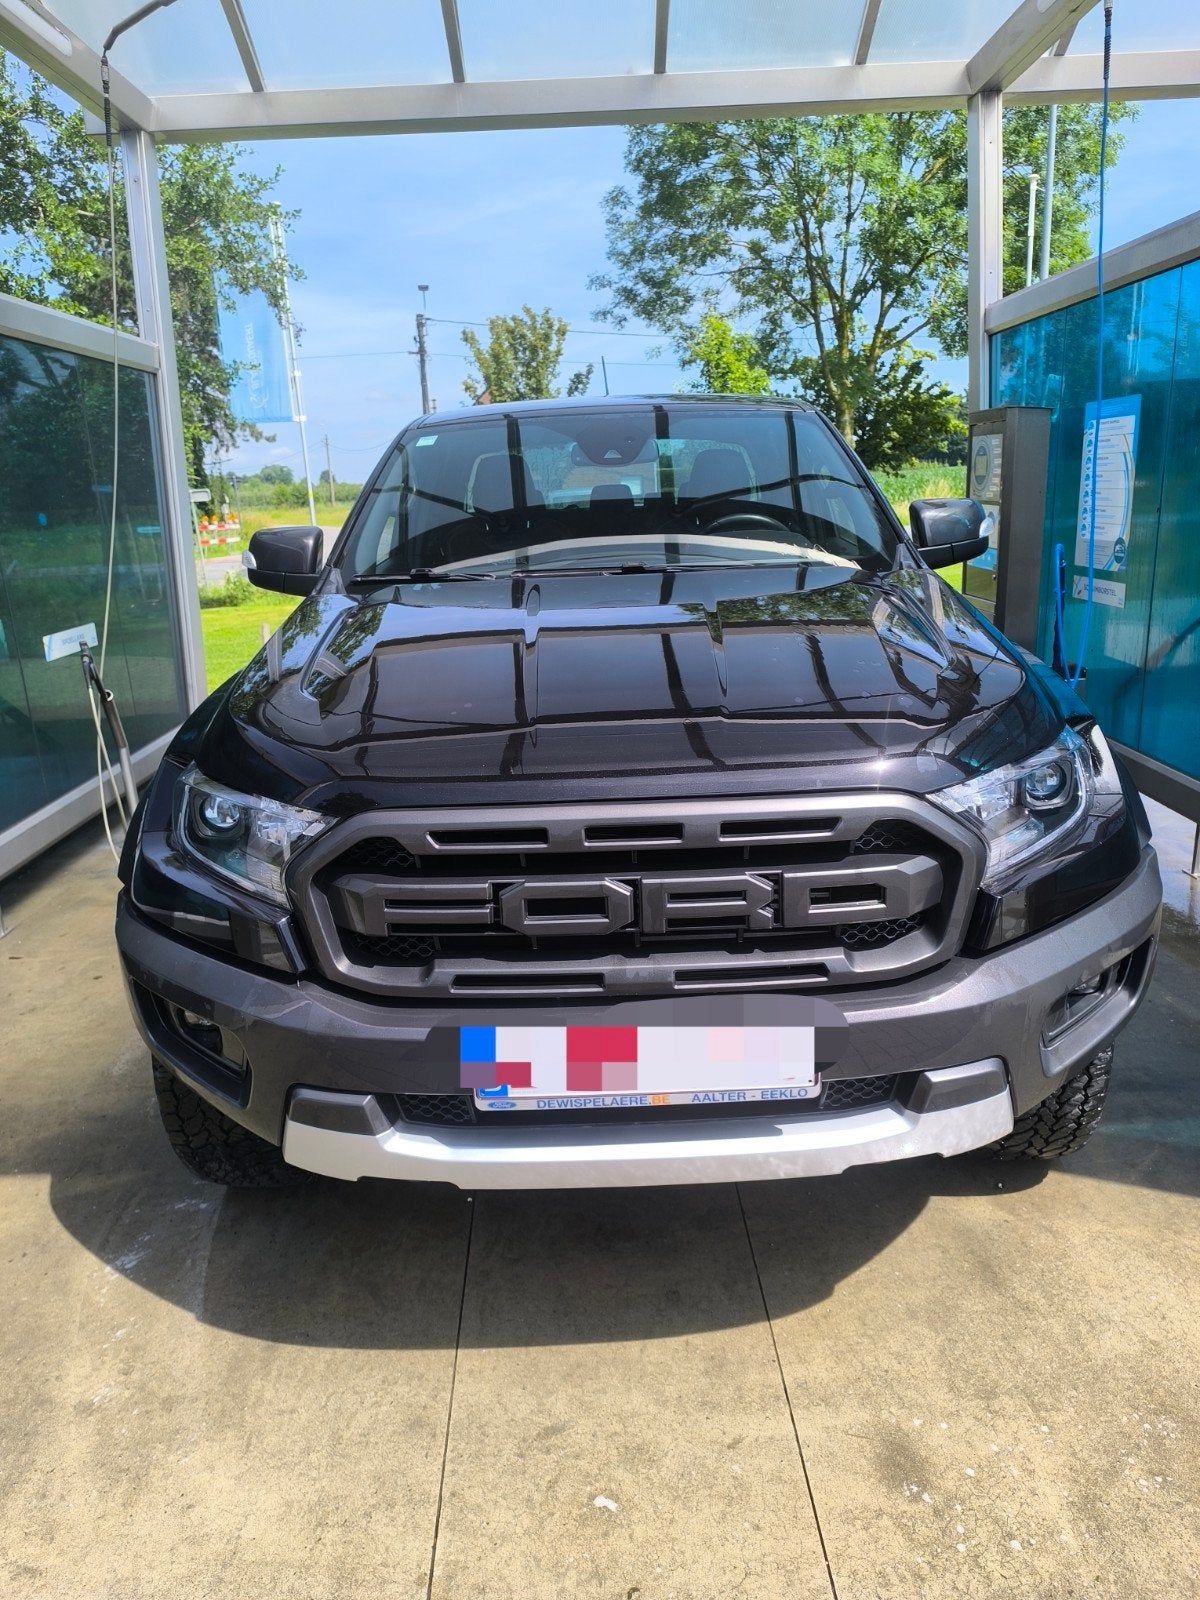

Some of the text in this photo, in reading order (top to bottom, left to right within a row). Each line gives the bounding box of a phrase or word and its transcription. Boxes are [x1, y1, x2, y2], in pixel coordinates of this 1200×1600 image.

[332, 855, 942, 936] FORD
[536, 1095, 671, 1109] DEWISPELAERE.BE
[691, 1092, 746, 1103] AALTER
[761, 1088, 808, 1099] EEKLO
